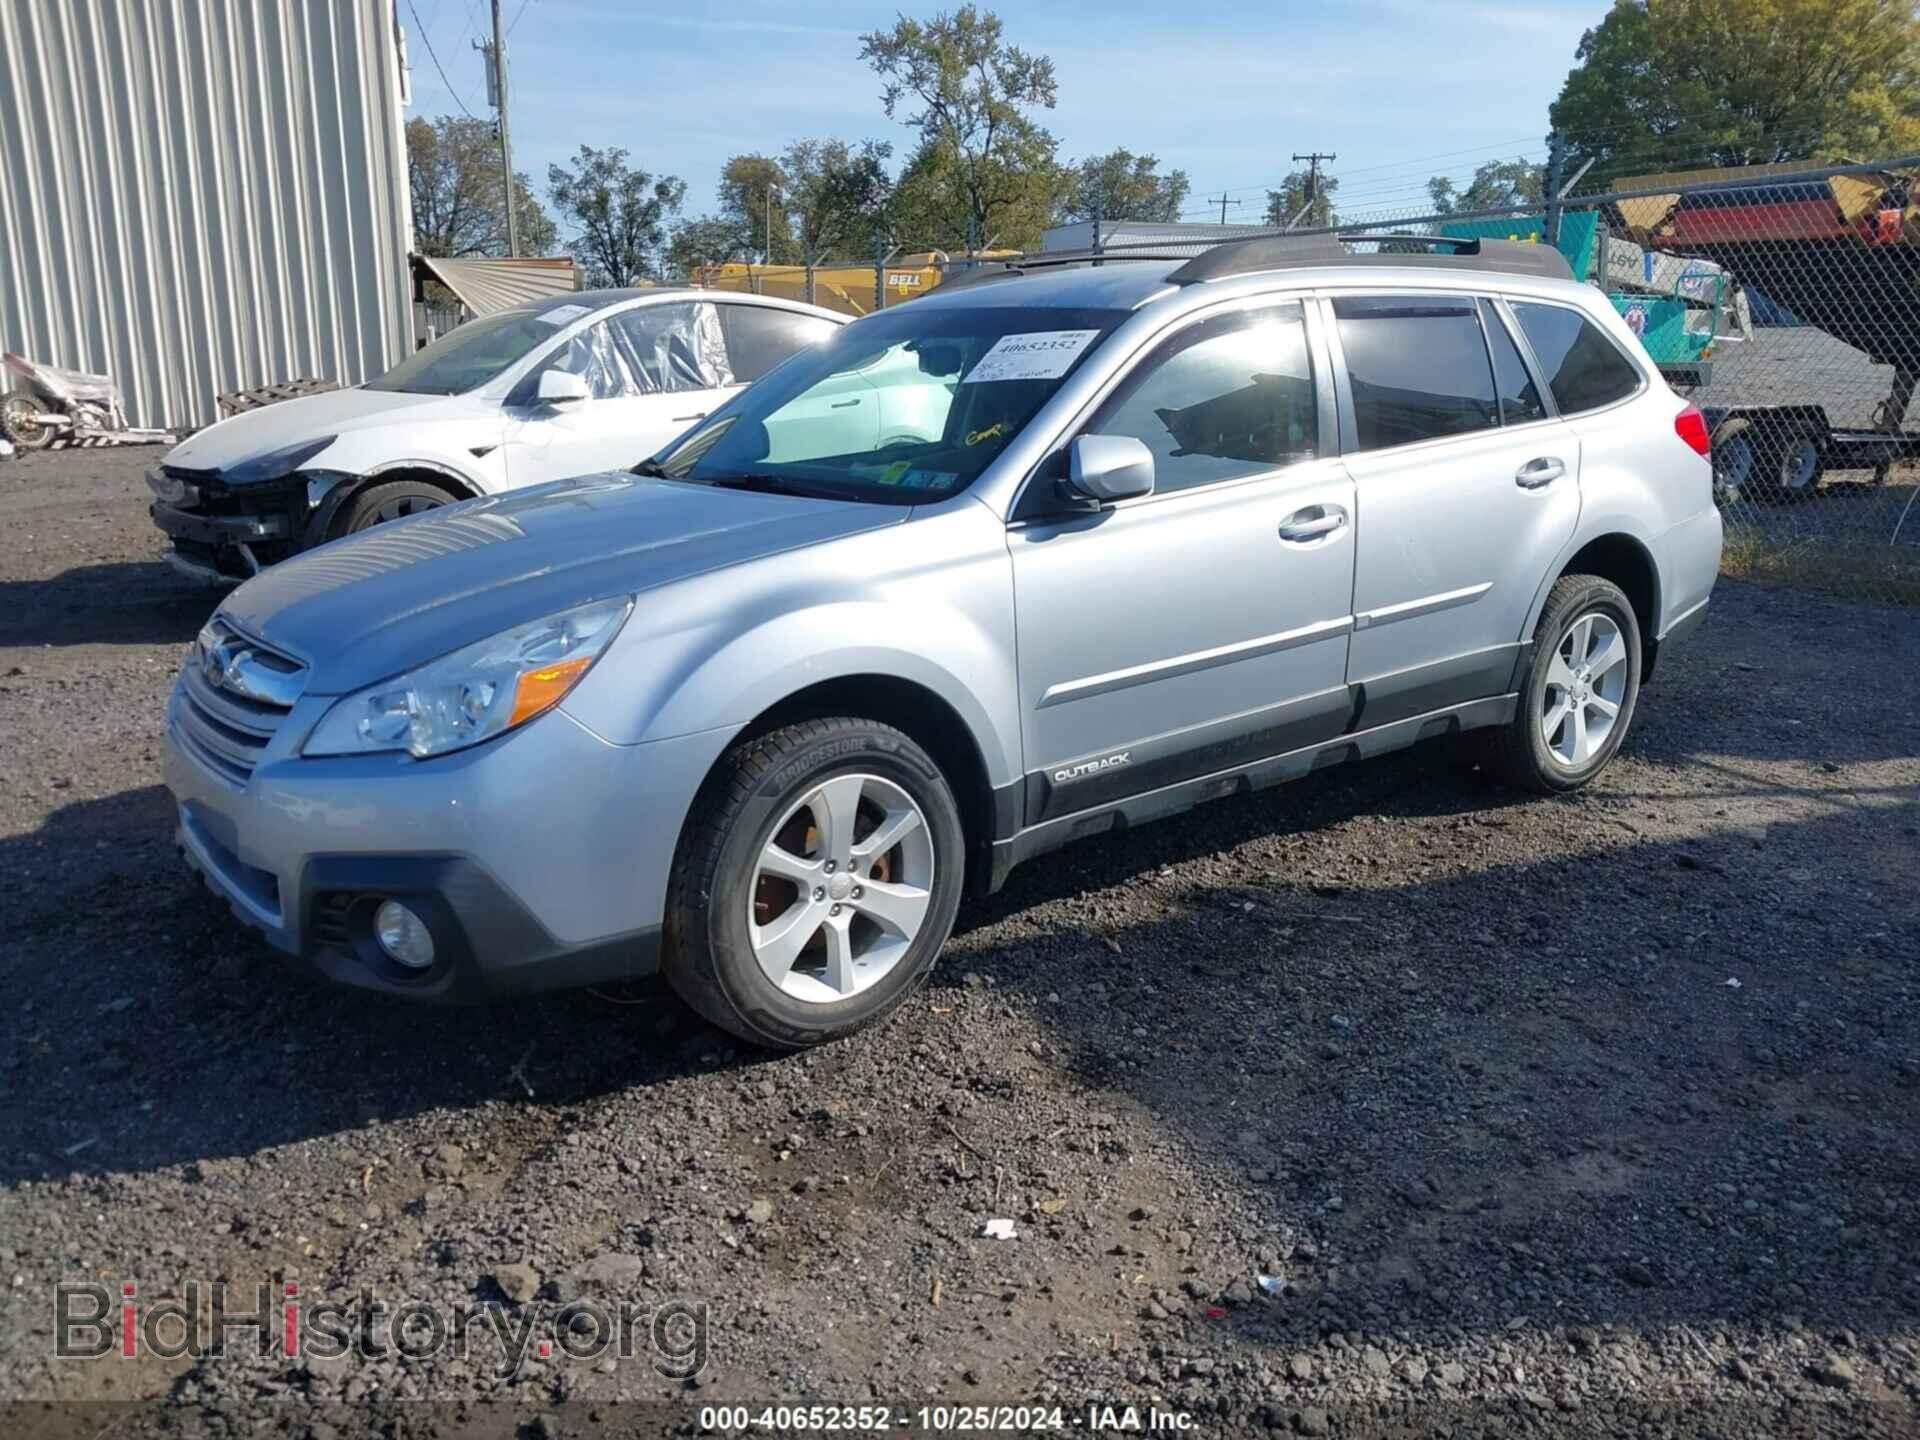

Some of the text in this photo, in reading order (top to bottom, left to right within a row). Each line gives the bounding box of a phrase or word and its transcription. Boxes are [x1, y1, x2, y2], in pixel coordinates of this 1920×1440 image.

[888, 274, 920, 285] BELL
[999, 340, 1077, 353] 40652352
[1054, 751, 1130, 782] OUTBACK
